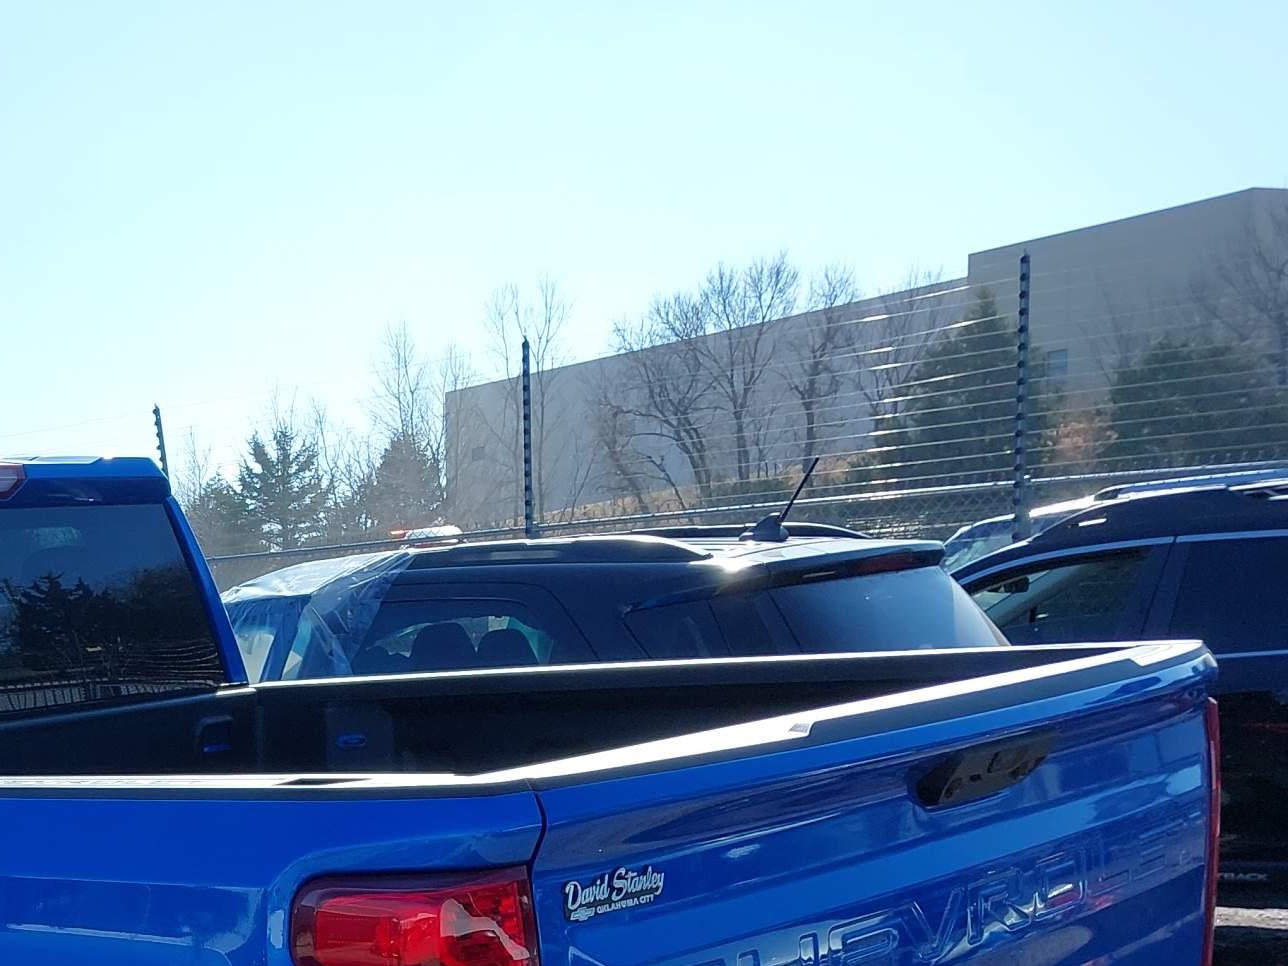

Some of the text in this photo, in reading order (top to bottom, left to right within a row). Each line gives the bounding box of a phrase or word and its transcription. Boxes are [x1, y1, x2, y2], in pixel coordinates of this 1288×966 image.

[565, 865, 665, 910] David Stanley
[596, 894, 654, 914] OKLAHOMA CITY
